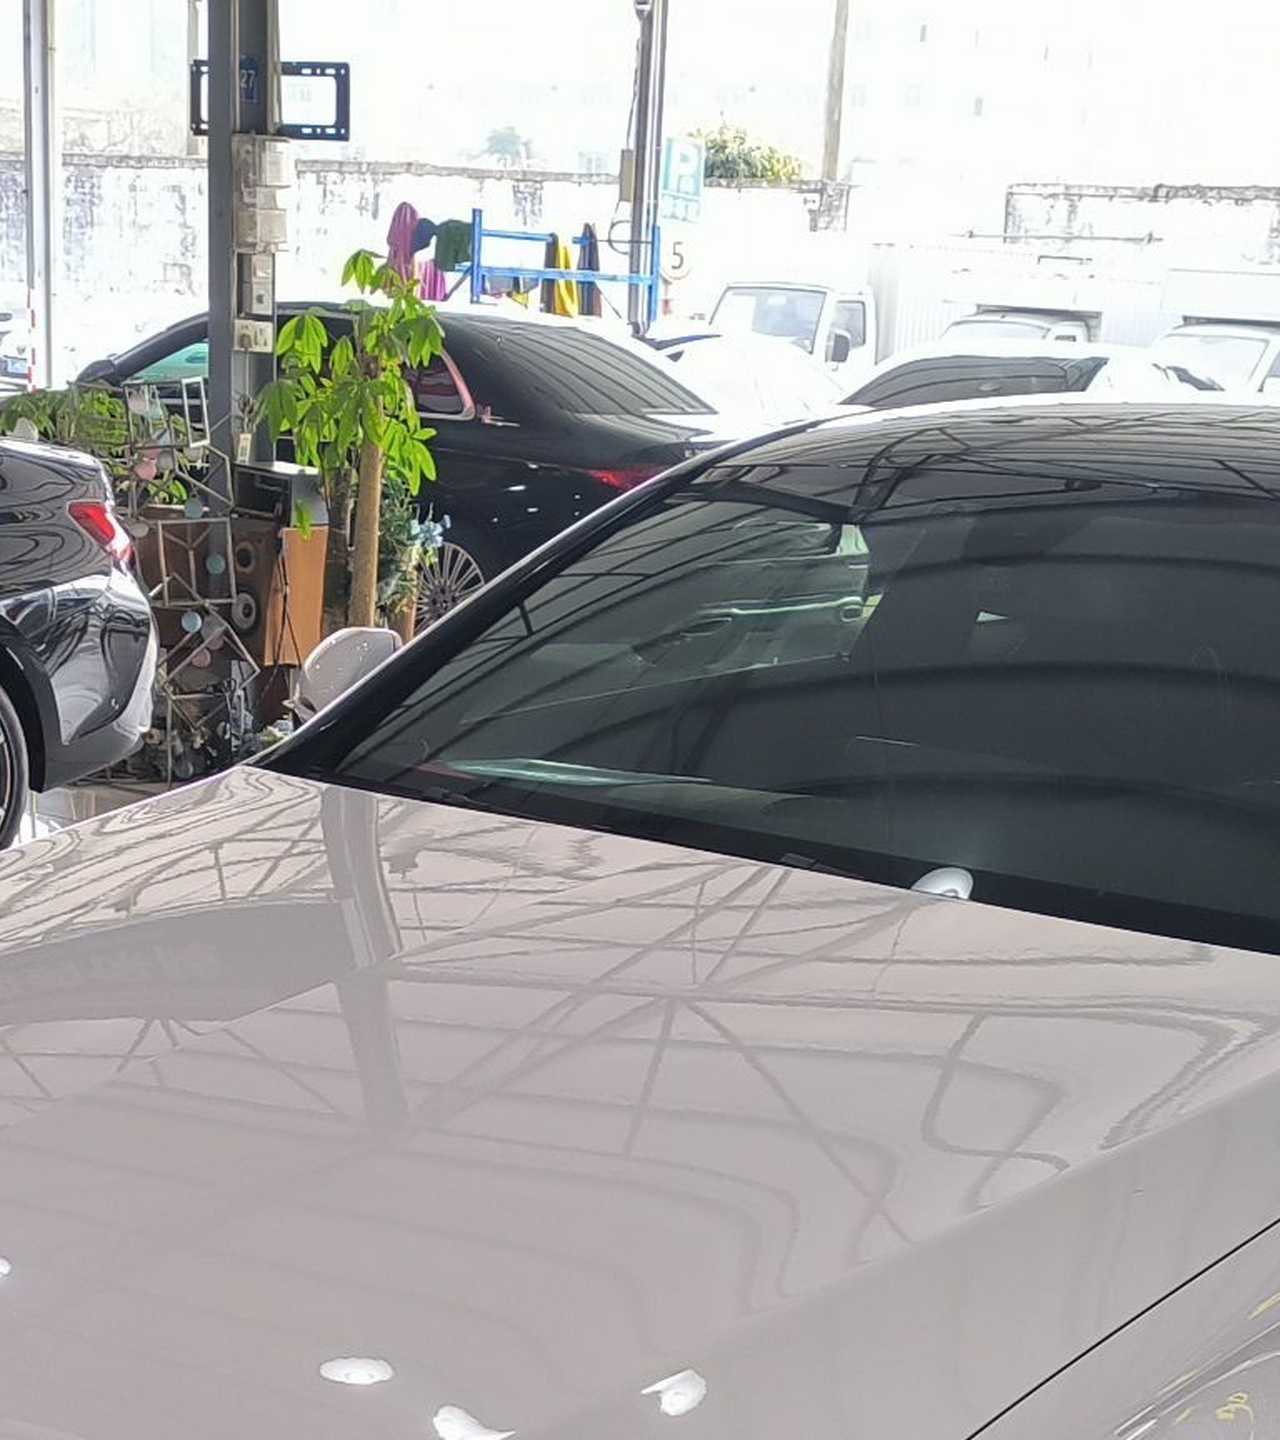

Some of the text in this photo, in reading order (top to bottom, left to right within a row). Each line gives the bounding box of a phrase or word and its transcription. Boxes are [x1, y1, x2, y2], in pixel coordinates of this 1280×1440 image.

[240, 69, 255, 91] 27
[668, 141, 697, 192] P
[671, 241, 684, 270] 5
